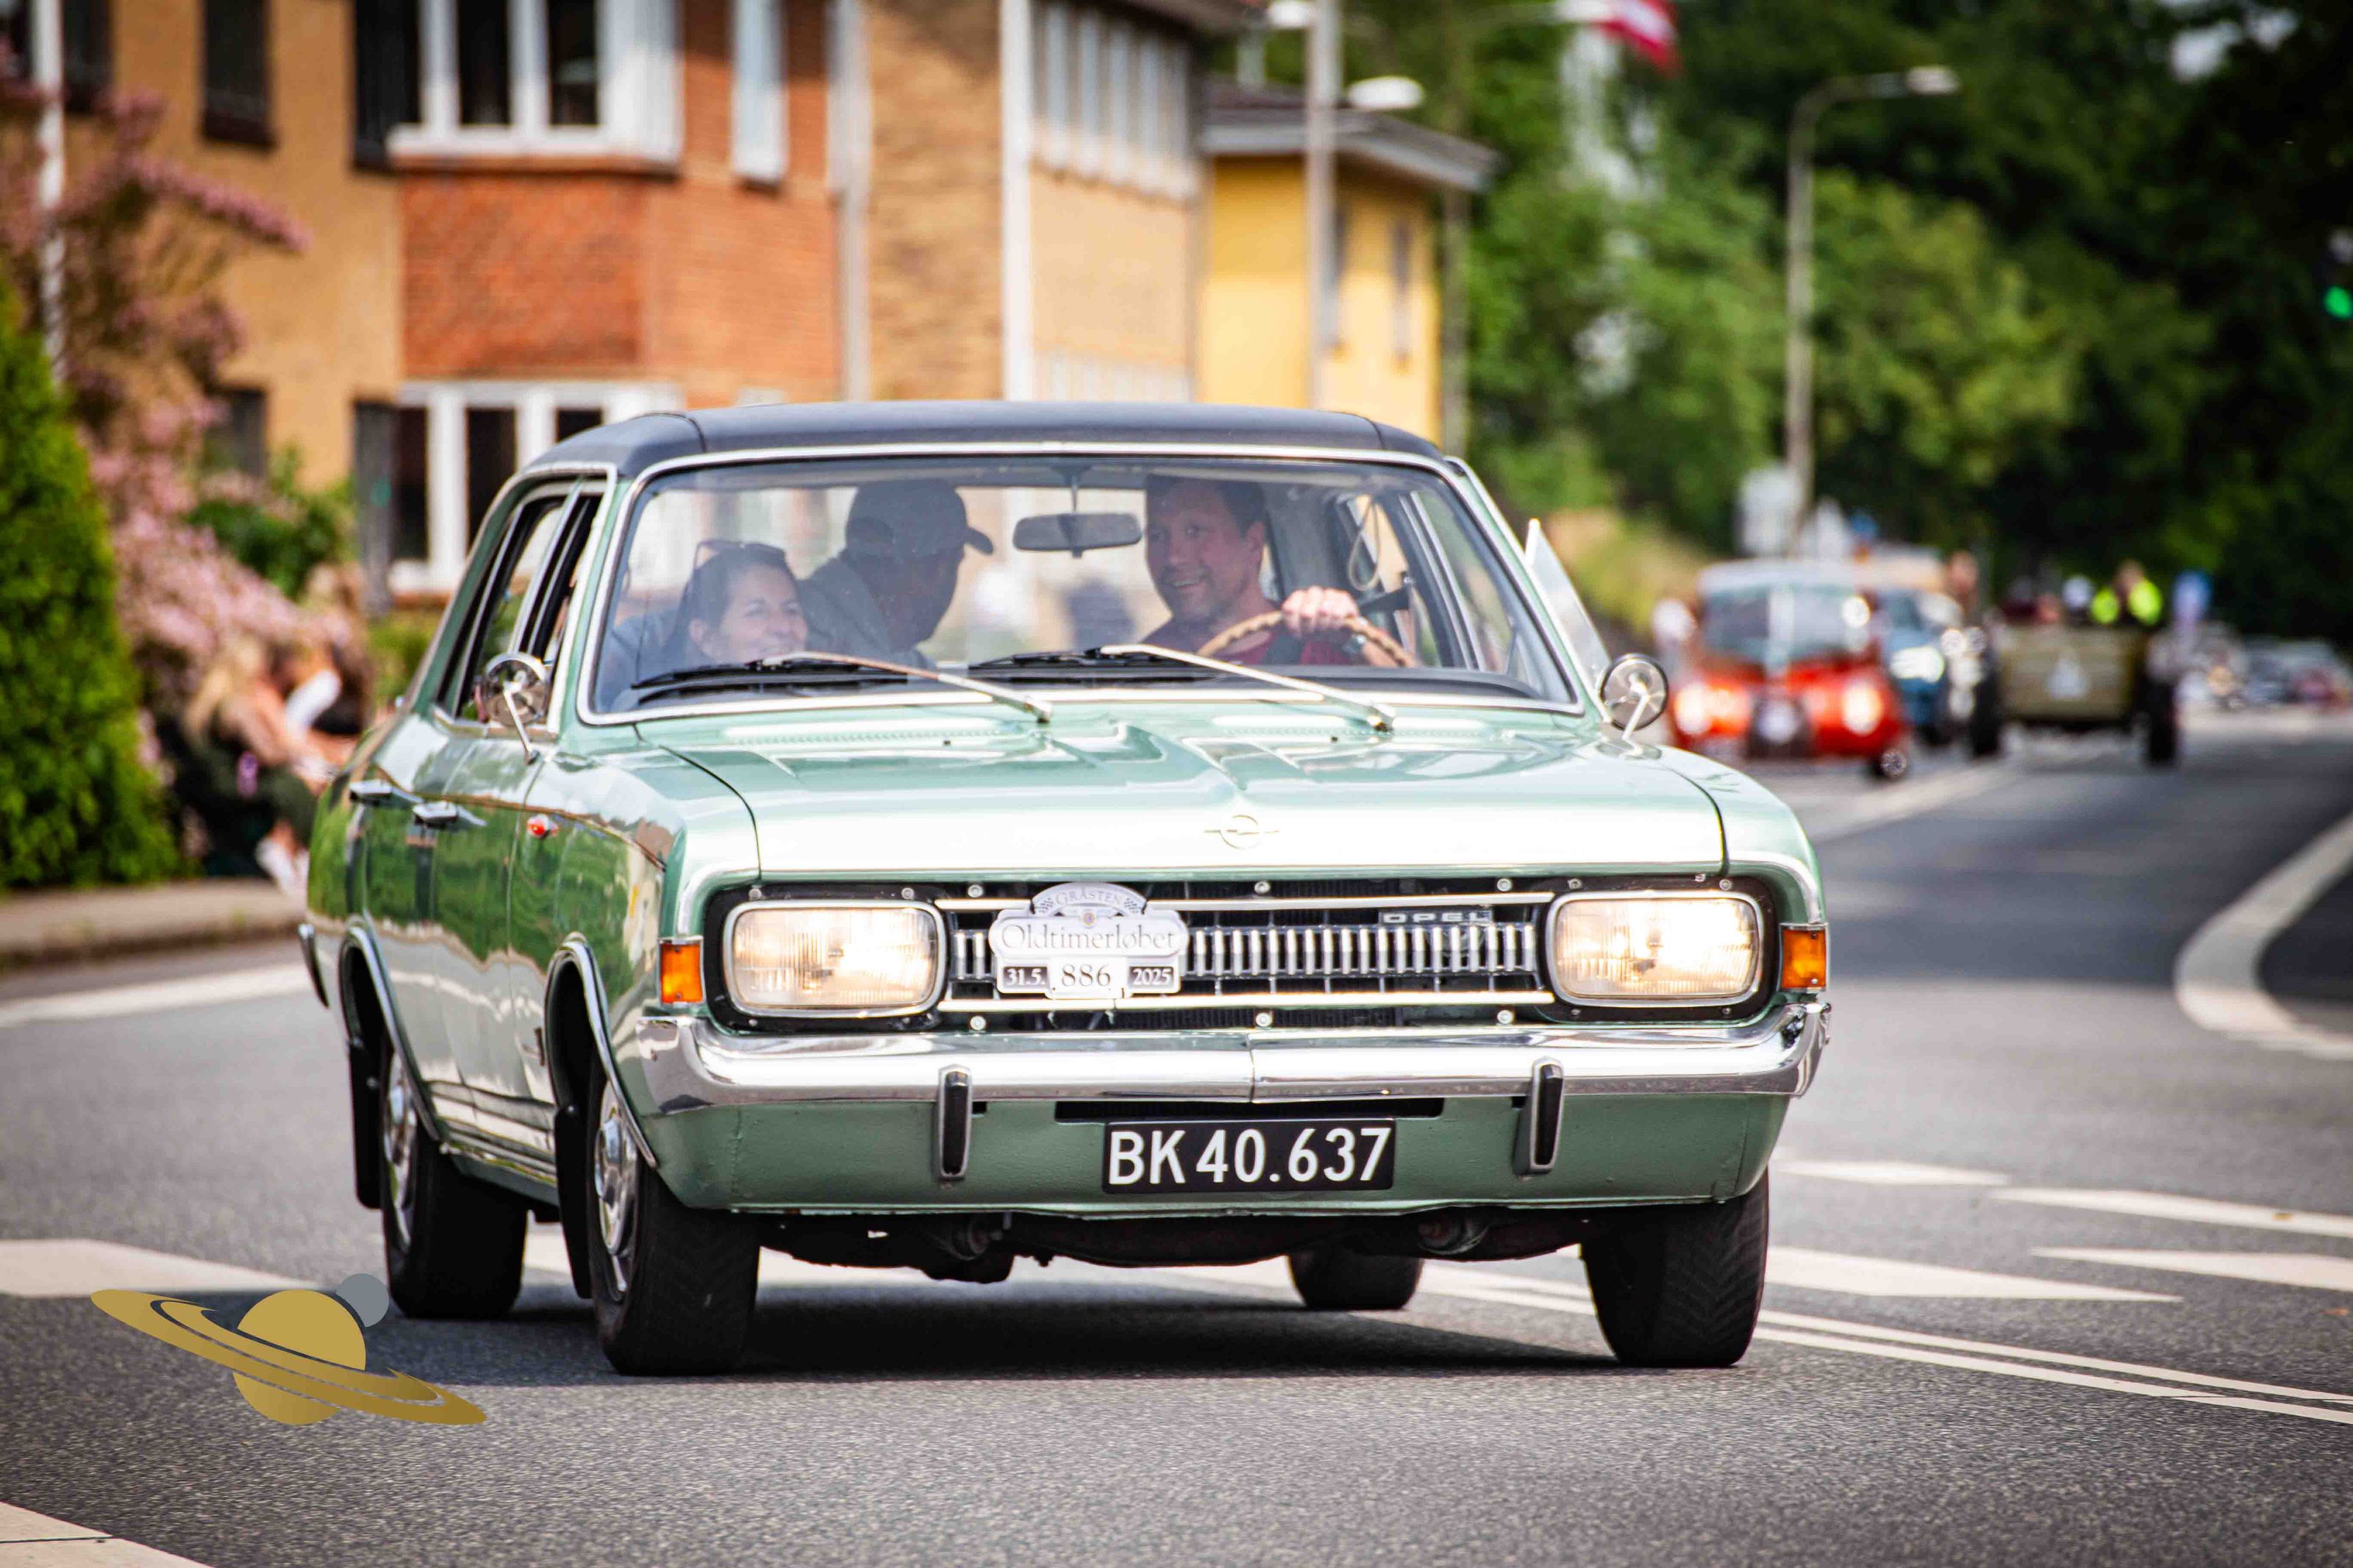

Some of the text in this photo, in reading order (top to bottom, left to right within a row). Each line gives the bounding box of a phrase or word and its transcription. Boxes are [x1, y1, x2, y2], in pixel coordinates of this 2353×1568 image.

[1382, 911, 1490, 923] OPEL
[1001, 923, 1176, 949] Oldtimerløbet
[1006, 963, 1171, 987] 31.5. 886 2025
[1109, 1127, 1392, 1185] BK 40.637
